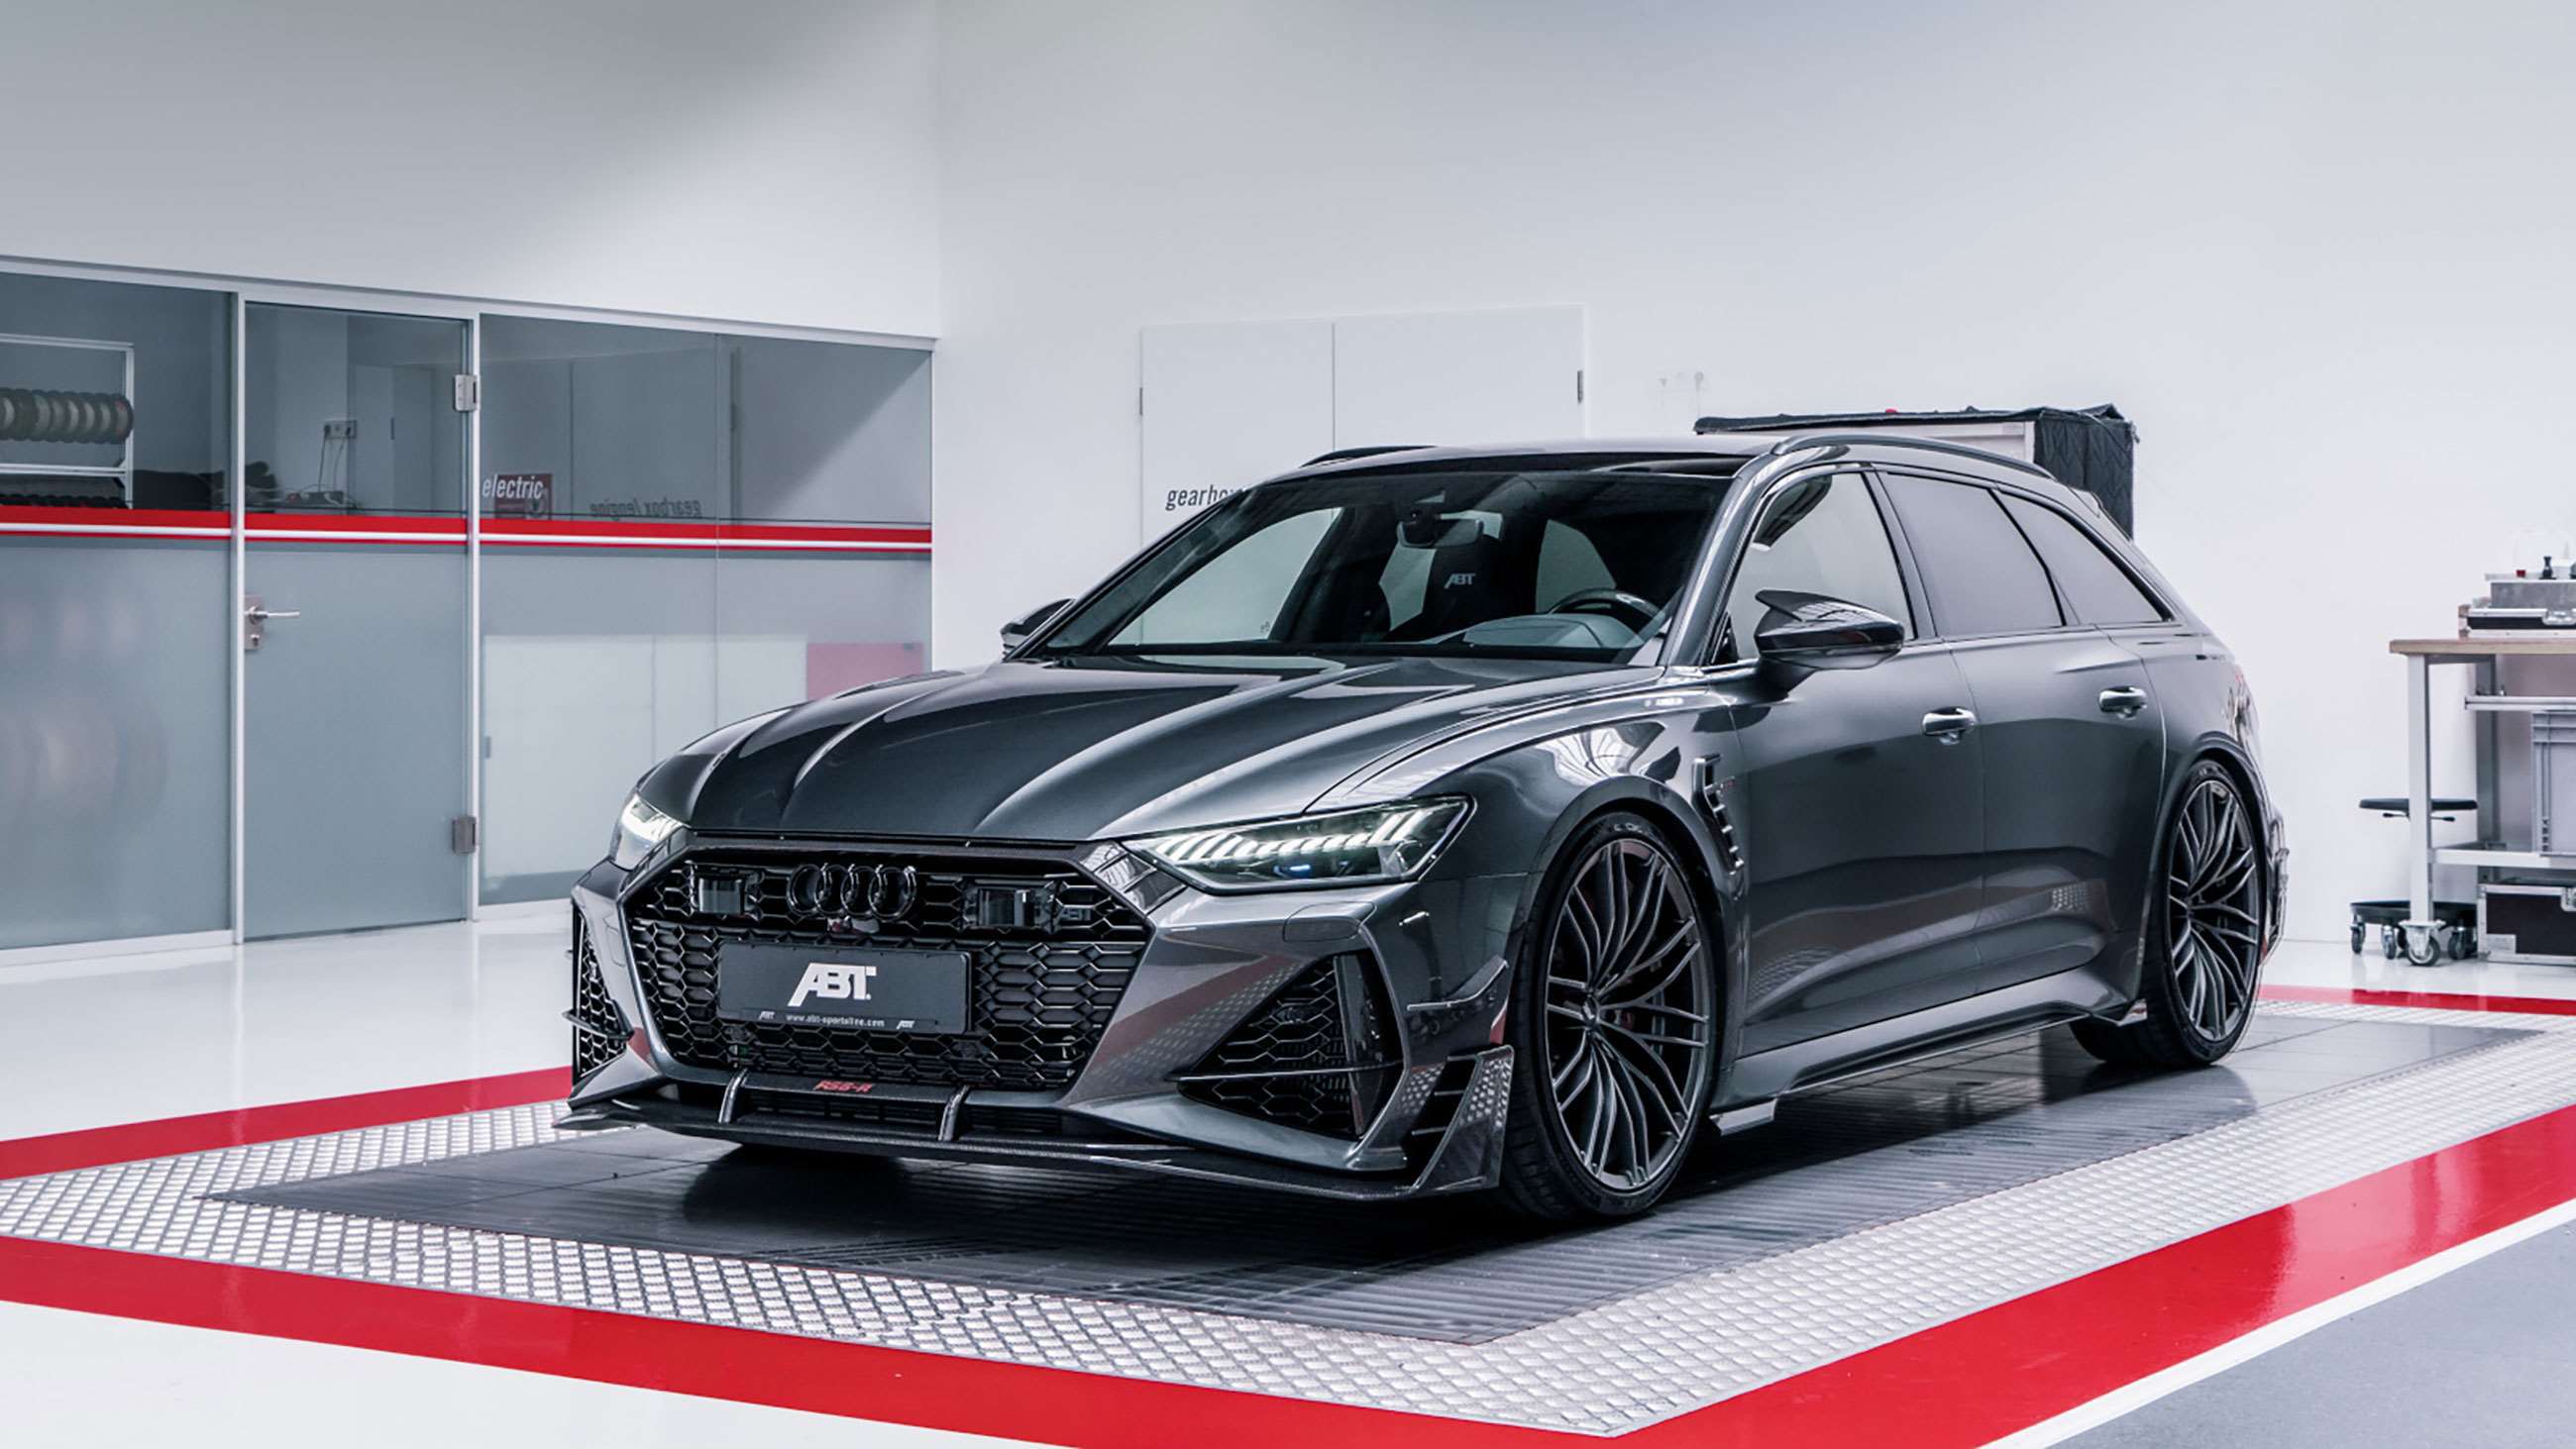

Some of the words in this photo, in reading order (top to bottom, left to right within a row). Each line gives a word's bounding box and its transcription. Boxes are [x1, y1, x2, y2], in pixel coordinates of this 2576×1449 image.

[482, 473, 544, 499] electric
[1165, 484, 1235, 511] gearb
[1445, 572, 1476, 589] ABT
